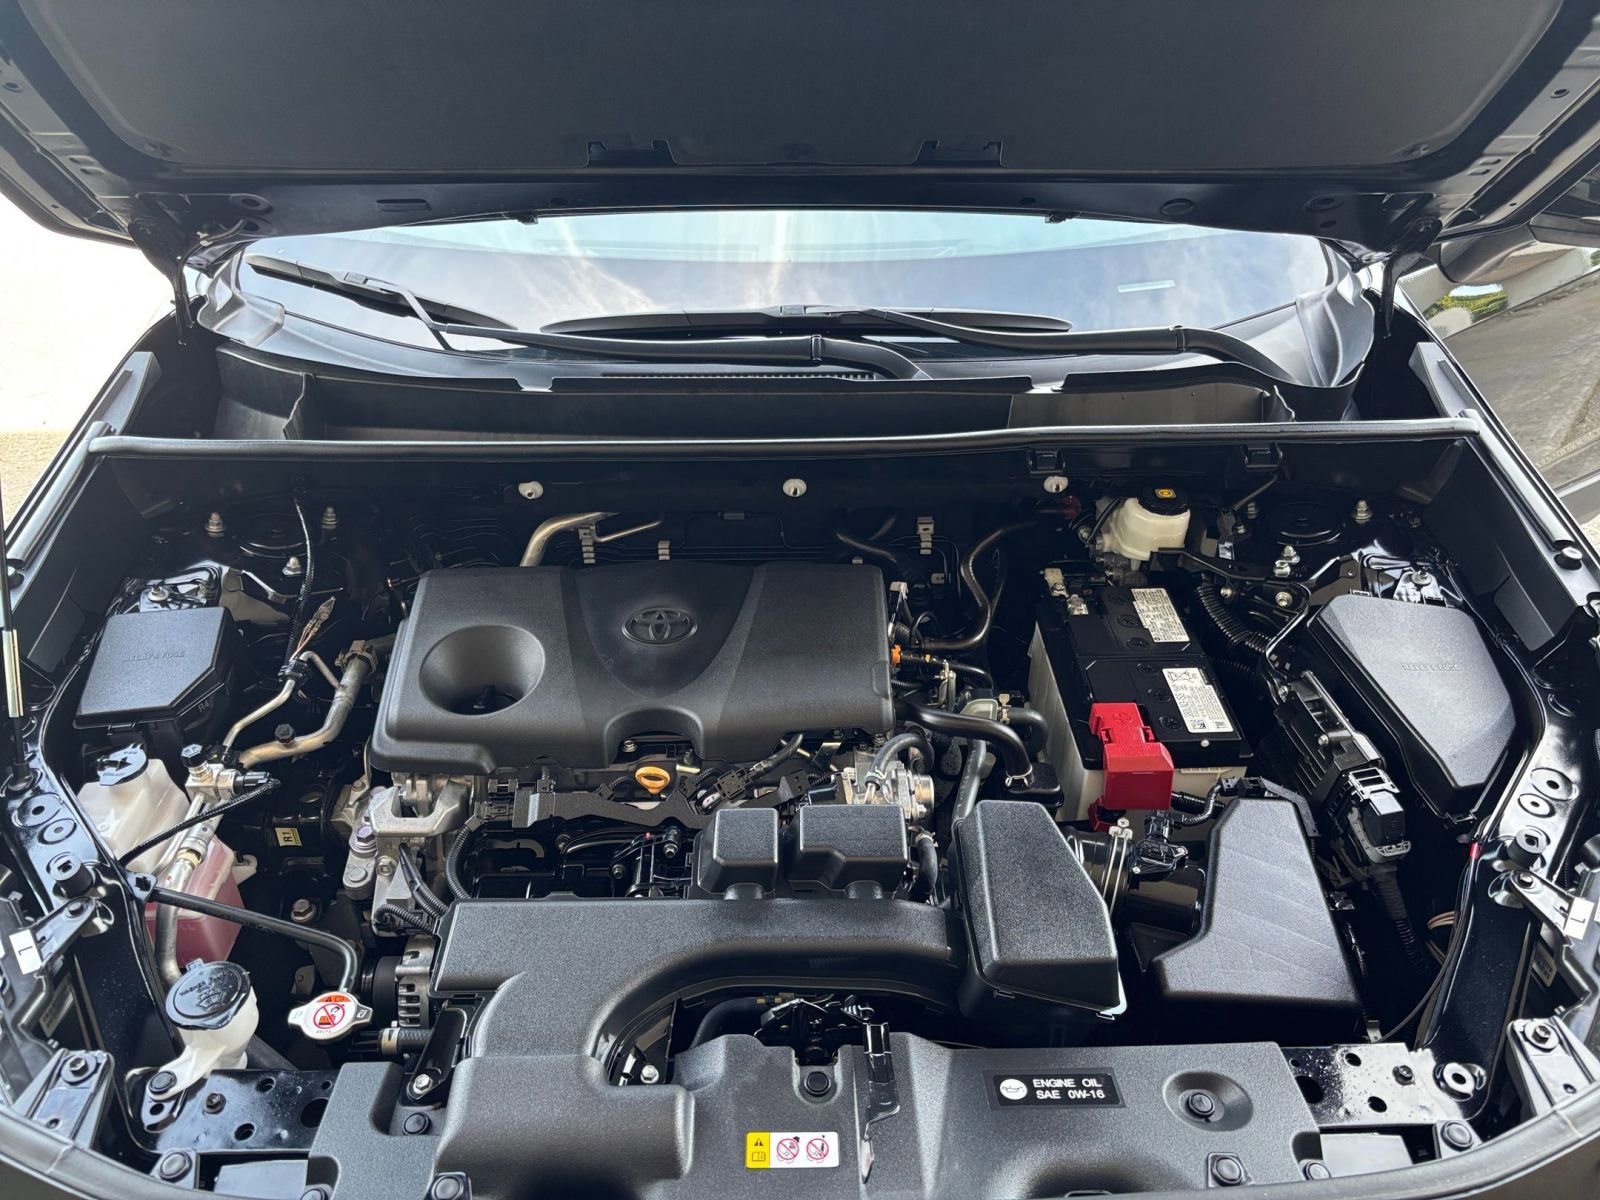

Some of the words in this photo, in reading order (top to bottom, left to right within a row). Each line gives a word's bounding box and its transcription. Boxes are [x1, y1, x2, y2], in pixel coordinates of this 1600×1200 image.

[1032, 1078, 1077, 1088] ENGINE
[1081, 1078, 1103, 1087] OIL
[1036, 1090, 1061, 1099] SAE
[1067, 1090, 1106, 1099] 0W-16
